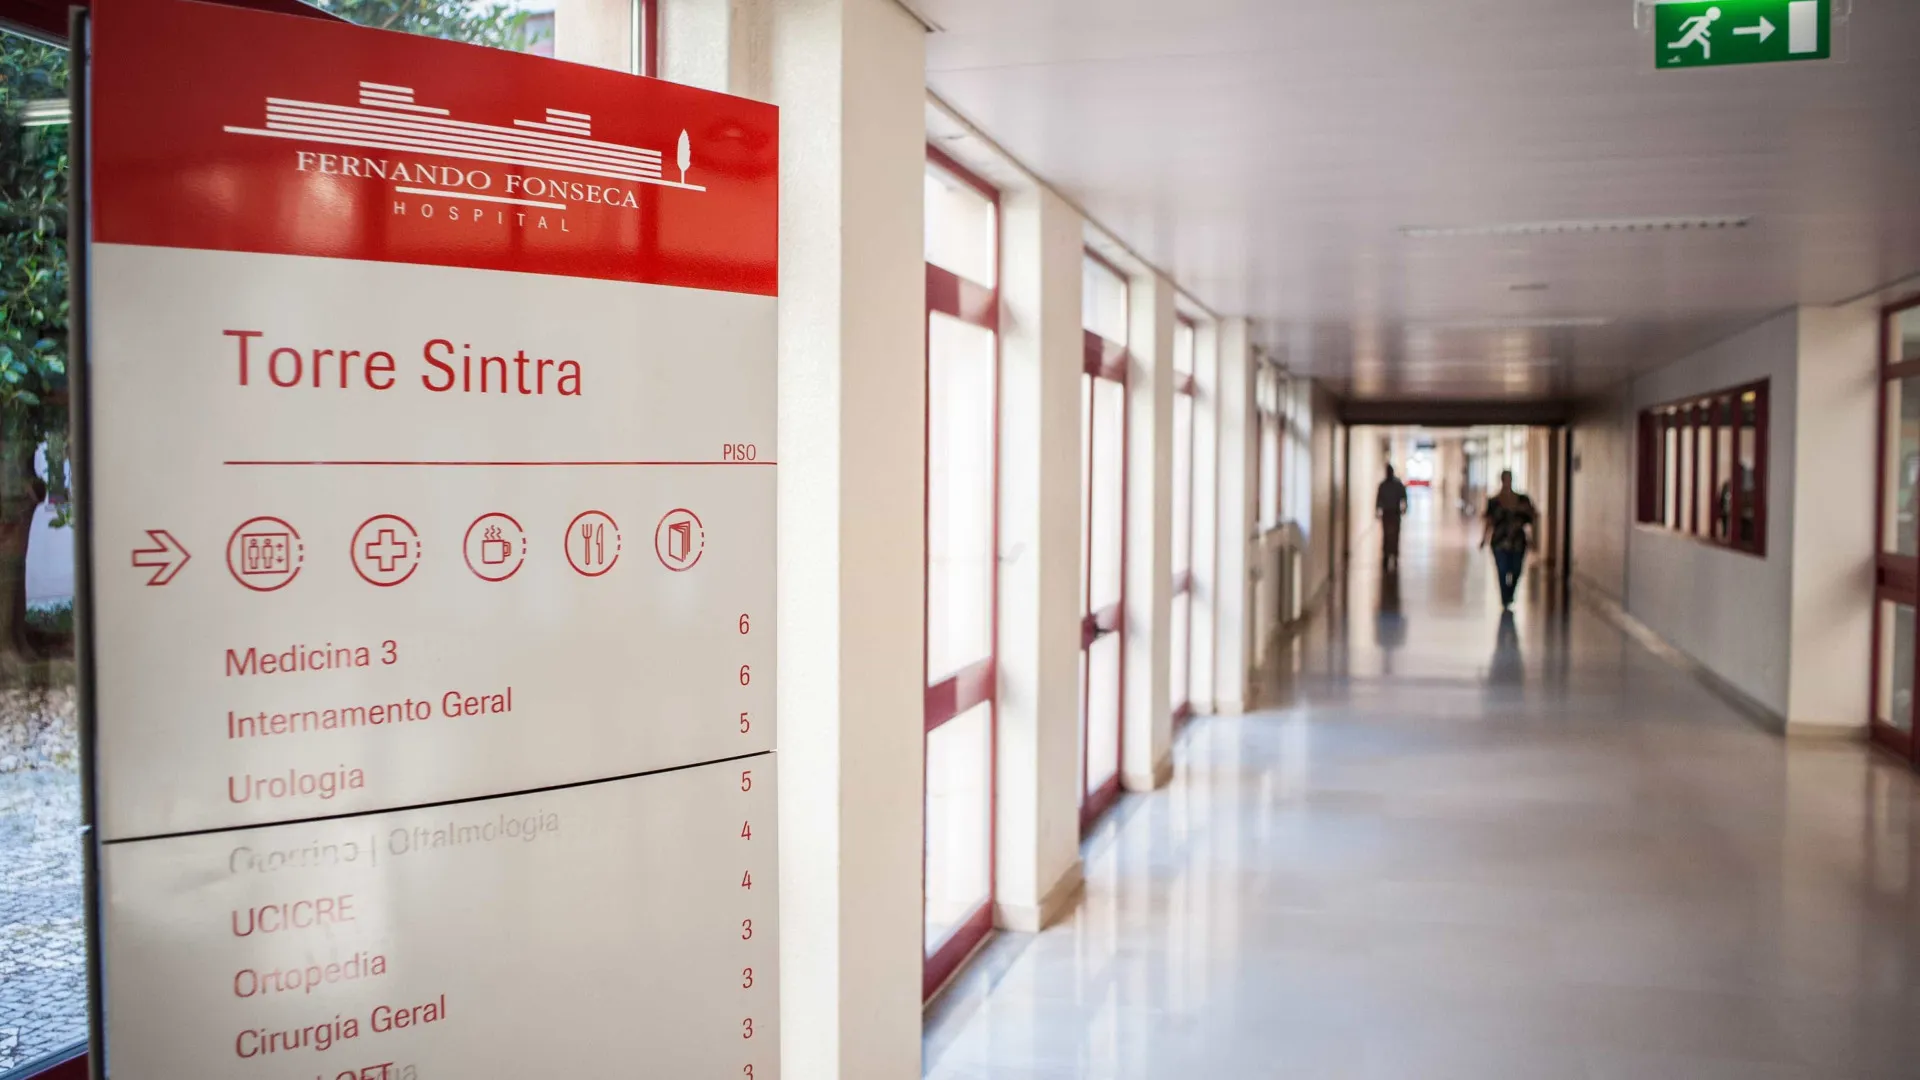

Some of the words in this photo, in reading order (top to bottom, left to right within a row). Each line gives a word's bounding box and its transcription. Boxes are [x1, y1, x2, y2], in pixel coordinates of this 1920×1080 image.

[295, 150, 492, 190] FERNANDO
[504, 173, 640, 209] FONSECA
[393, 200, 570, 233] HOSPITAL
[222, 329, 397, 390] Torre
[420, 338, 583, 397] Sintra
[722, 443, 757, 462] PISO
[739, 613, 750, 635] 6
[225, 642, 370, 677] Medicina
[380, 639, 398, 665] 3
[739, 664, 751, 686] 6
[227, 697, 432, 739] Internamento
[441, 686, 513, 718] Geral
[739, 712, 750, 734] 5
[228, 764, 365, 804] Urologia
[741, 770, 752, 792] 5
[388, 807, 560, 856] Oftalmologia
[740, 820, 752, 842] 4
[741, 869, 752, 890] 4
[232, 894, 356, 938] UCICRE
[741, 918, 753, 940] 3
[234, 951, 387, 998] Ortopedia
[742, 967, 753, 989] 3
[235, 1014, 359, 1059] Cirurgia
[370, 994, 446, 1033] Geral
[742, 1017, 754, 1039] 3
